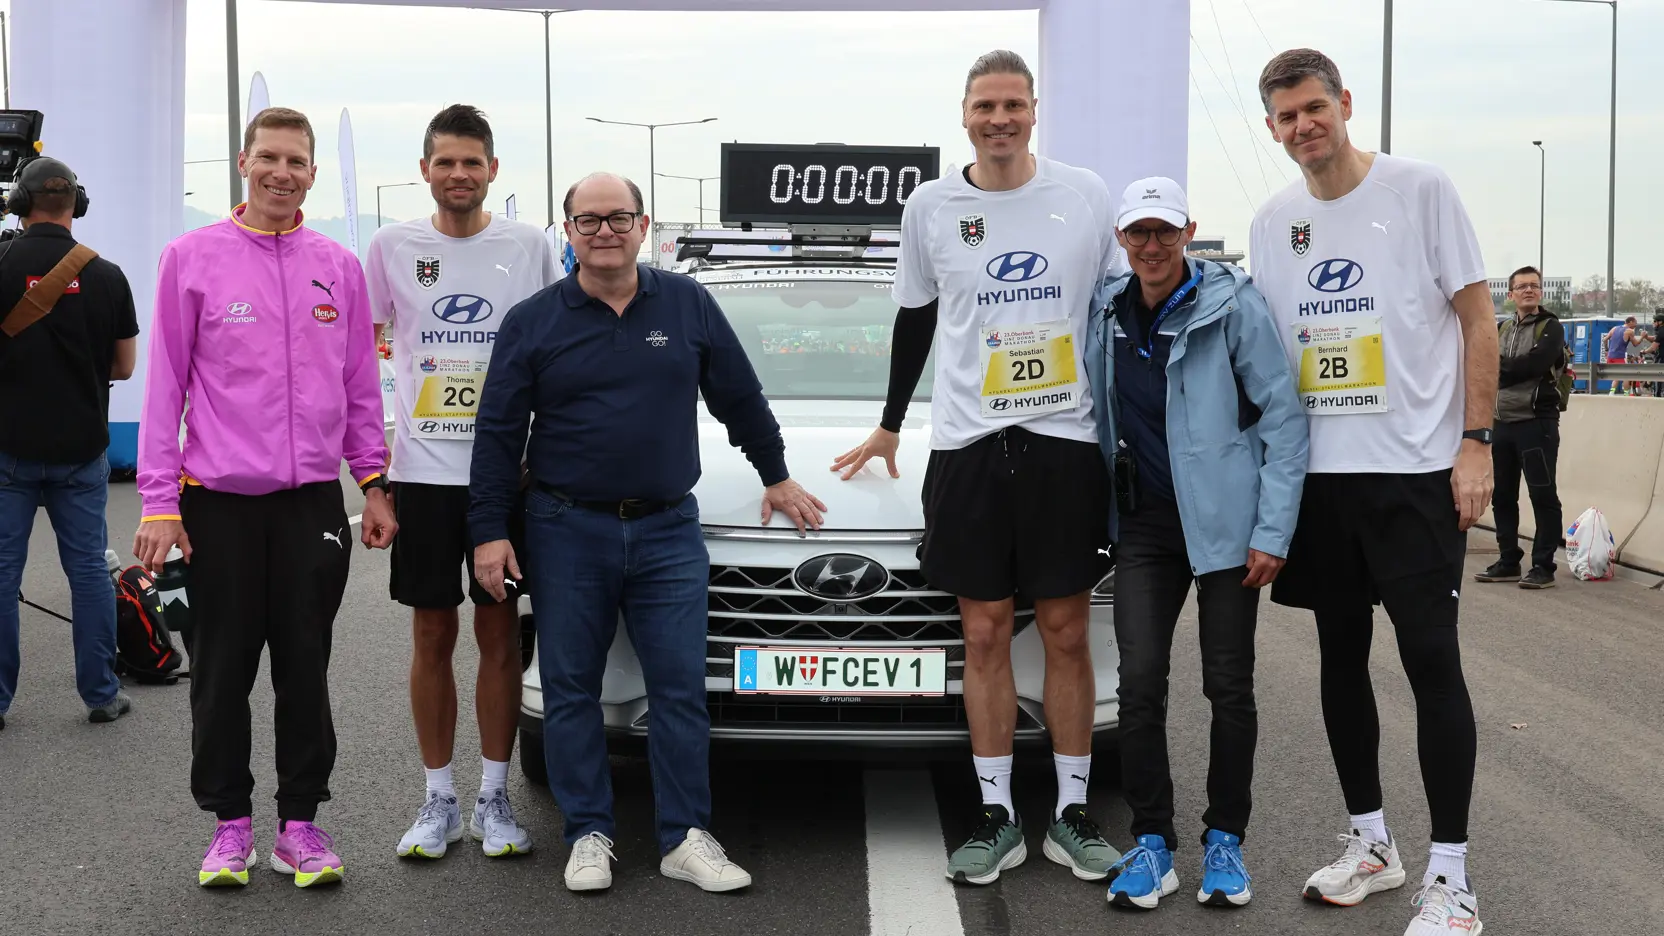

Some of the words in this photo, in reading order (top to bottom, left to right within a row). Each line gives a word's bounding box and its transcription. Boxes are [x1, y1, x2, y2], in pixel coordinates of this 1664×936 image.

[770, 164, 922, 205] 0:00:00
[977, 286, 1061, 306] HYUNDAI
[314, 308, 337, 319] Hervis
[1299, 297, 1374, 316] HYUNDAI
[1009, 348, 1045, 357] Sebastian
[1012, 359, 1045, 381] 2D
[1319, 357, 1348, 379] 2B
[444, 387, 476, 407] 2C
[1014, 392, 1072, 408] HYUNDAI
[1320, 395, 1378, 406] HYUNDAI
[744, 676, 752, 684] A
[774, 655, 797, 686] W
[822, 657, 900, 687] FCEV
[909, 657, 921, 688] 1
